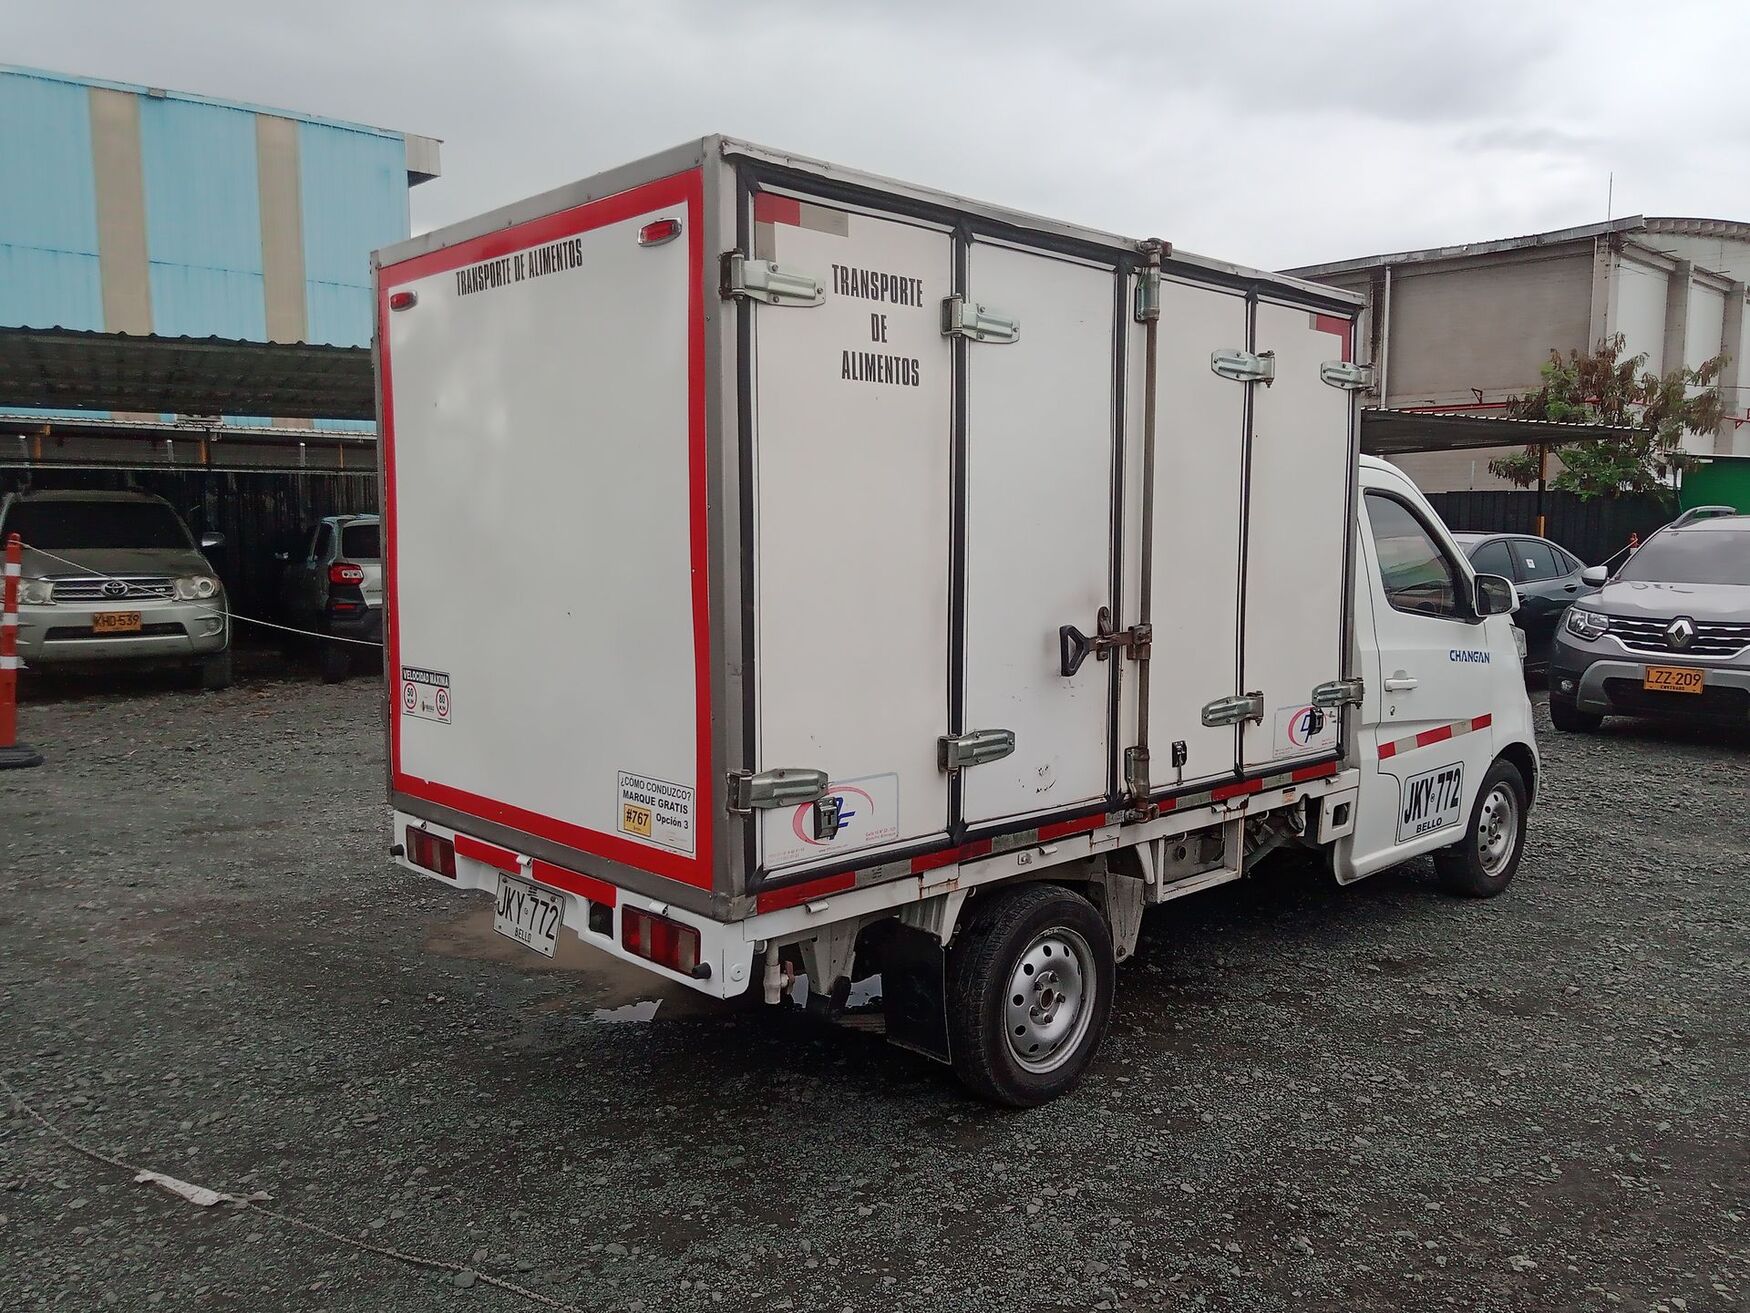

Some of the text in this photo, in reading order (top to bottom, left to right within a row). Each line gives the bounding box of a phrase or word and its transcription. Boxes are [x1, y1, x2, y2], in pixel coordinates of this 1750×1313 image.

[456, 239, 582, 296] TRANSPORTE DE ALIMENTOS
[832, 264, 923, 308] TRANSPORTE
[871, 313, 888, 343] DE
[841, 350, 920, 387] ALIMENTOS
[1450, 650, 1489, 663] CHANGAN
[402, 669, 430, 684] VELOCIDAD
[620, 776, 692, 801] ¿CÓMO CONDUZCO?
[1404, 768, 1460, 824] JKY 772
[623, 789, 688, 814] MARQUE GRATIS
[626, 808, 649, 826] #767
[656, 813, 689, 829] Opción 3
[1416, 817, 1443, 833] BELLO
[497, 886, 559, 940] JKY 772
[515, 927, 532, 943] BELLO
